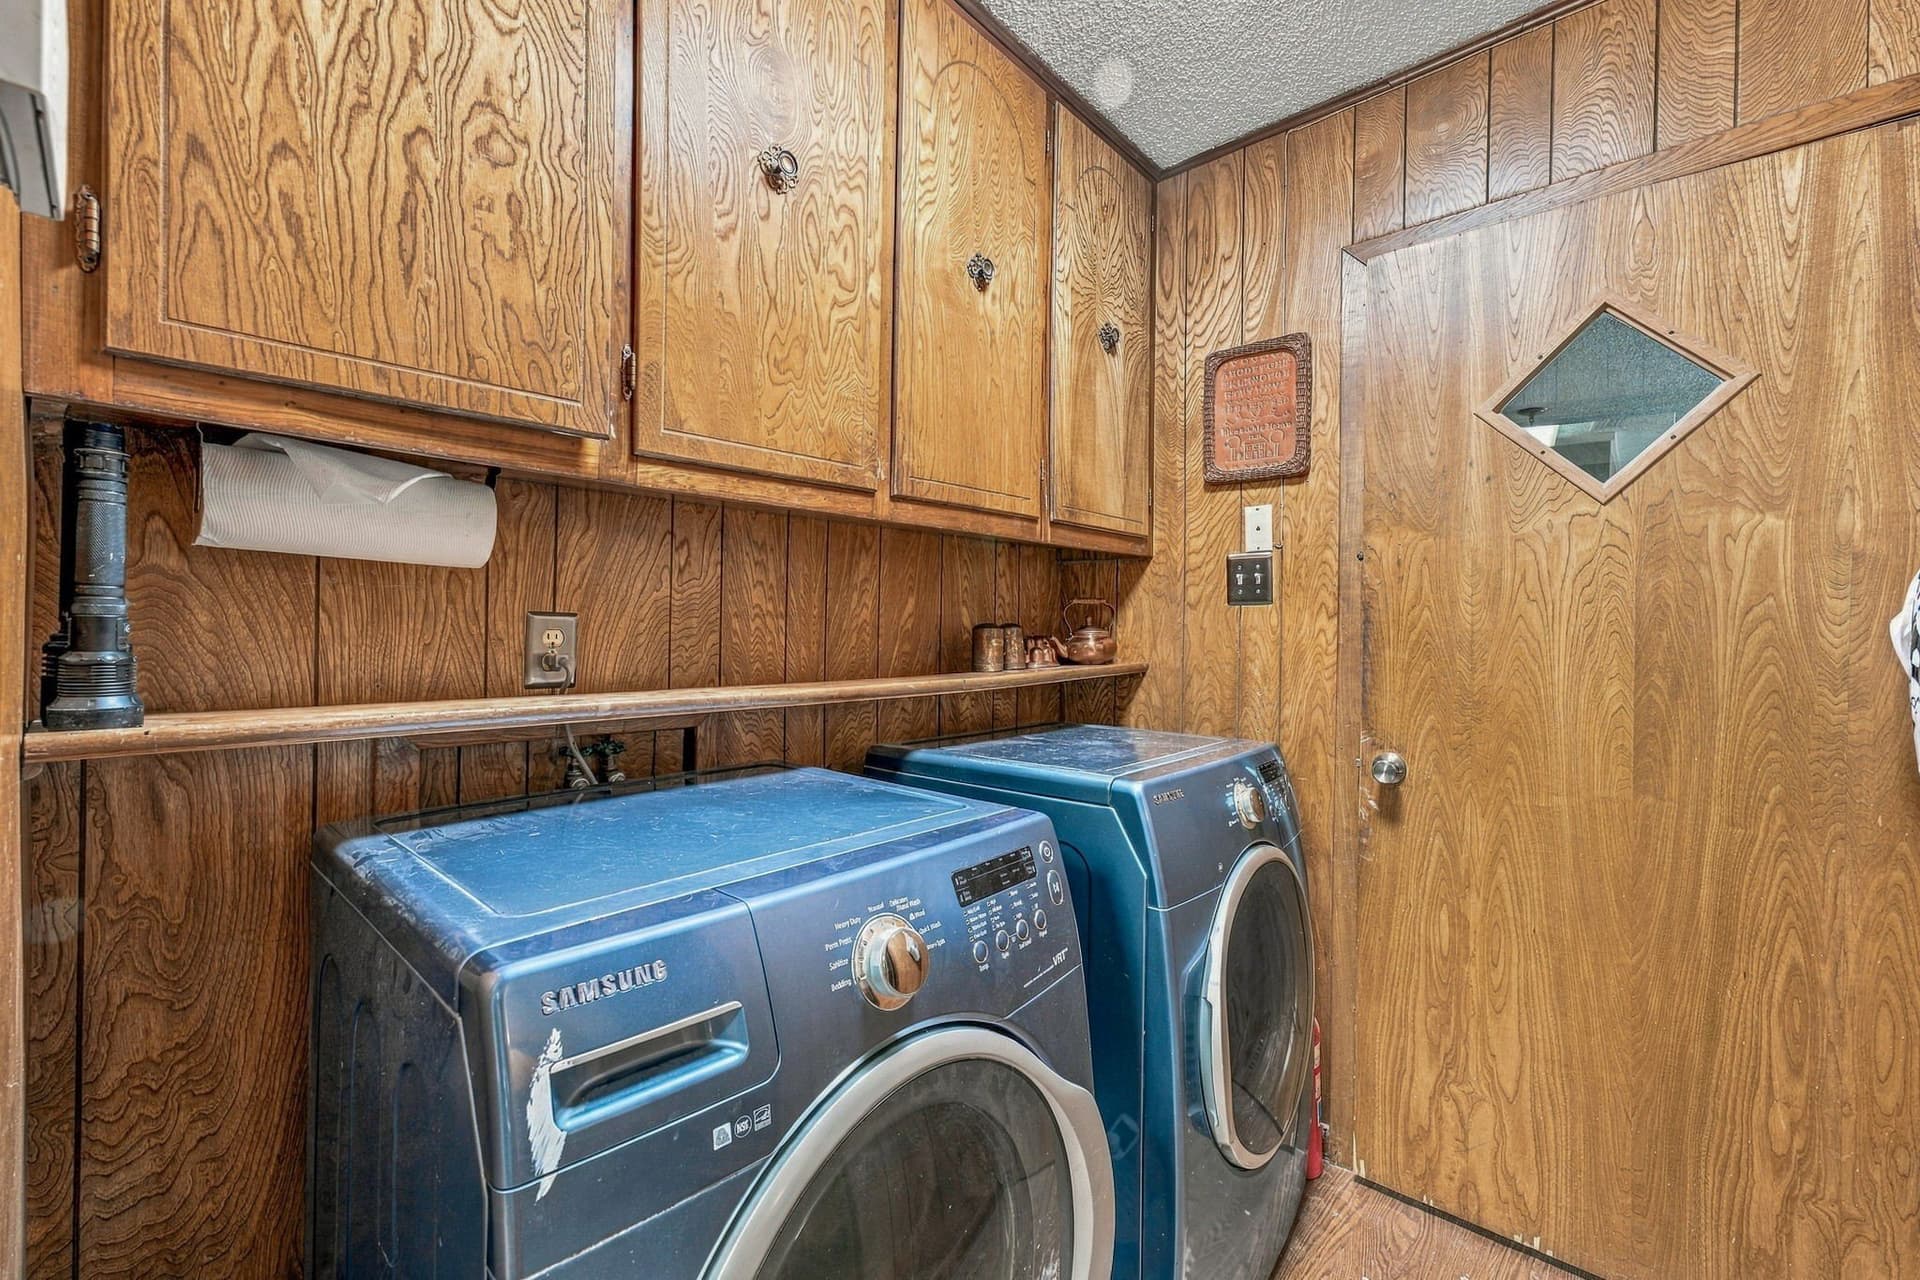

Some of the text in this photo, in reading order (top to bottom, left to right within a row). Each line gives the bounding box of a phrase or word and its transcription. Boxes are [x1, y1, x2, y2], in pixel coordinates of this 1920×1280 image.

[834, 916, 862, 931] Heavy Duty
[825, 936, 853, 952] Perm Press
[540, 959, 667, 1016] SAMSUNG
[831, 978, 852, 992] Bedding
